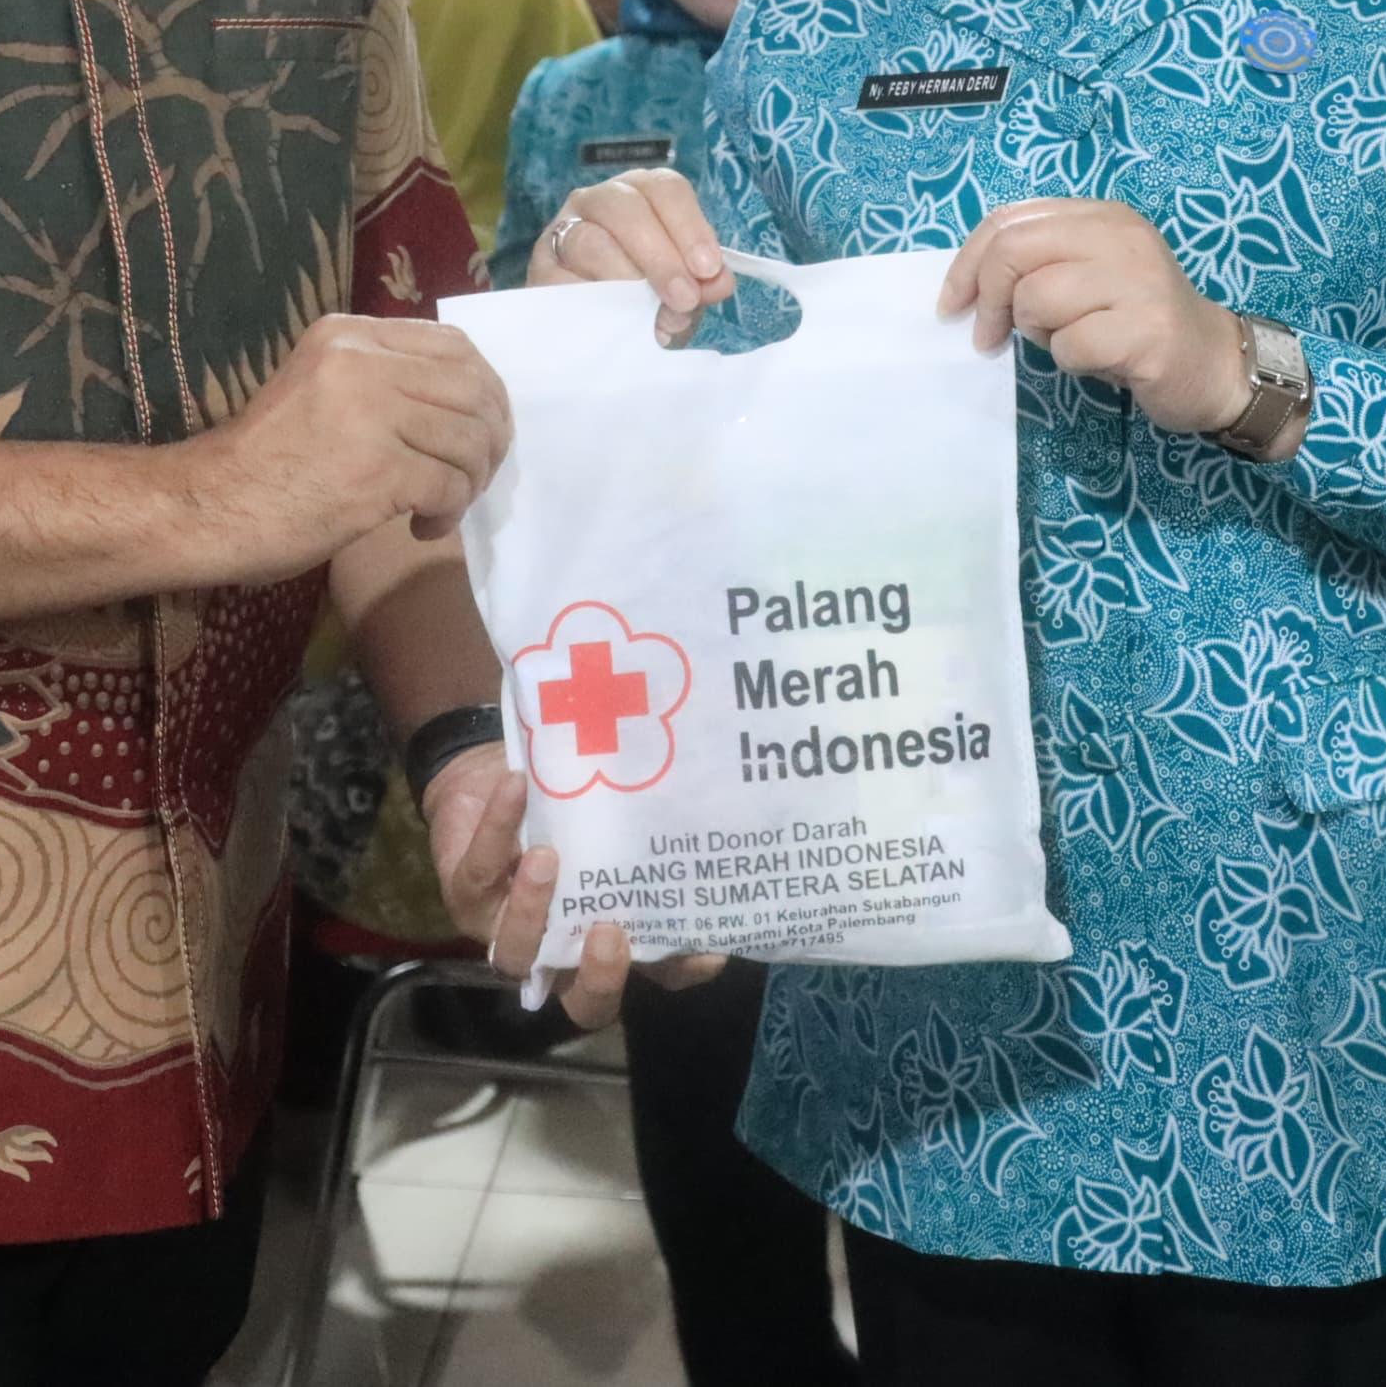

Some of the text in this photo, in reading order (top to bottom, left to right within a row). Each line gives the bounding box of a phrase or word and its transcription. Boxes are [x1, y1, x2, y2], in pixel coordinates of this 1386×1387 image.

[869, 74, 999, 101] Ny. FEBY HERMAN DERU
[726, 580, 911, 635] Palang
[733, 648, 900, 710] Merah
[740, 712, 992, 782] Indonesia
[578, 834, 945, 891] PALANG MERAH INDONESIA
[650, 815, 868, 856] Unit Donor Darah
[562, 857, 965, 917] PROVINSI SUMATERA SELATAN
[694, 916, 714, 931] 06
[753, 911, 772, 925] 01
[776, 902, 858, 924] Kelurahan
[862, 890, 961, 914] Sukabangun
[629, 912, 917, 948] ecamatan Sukarami Kota Palembang
